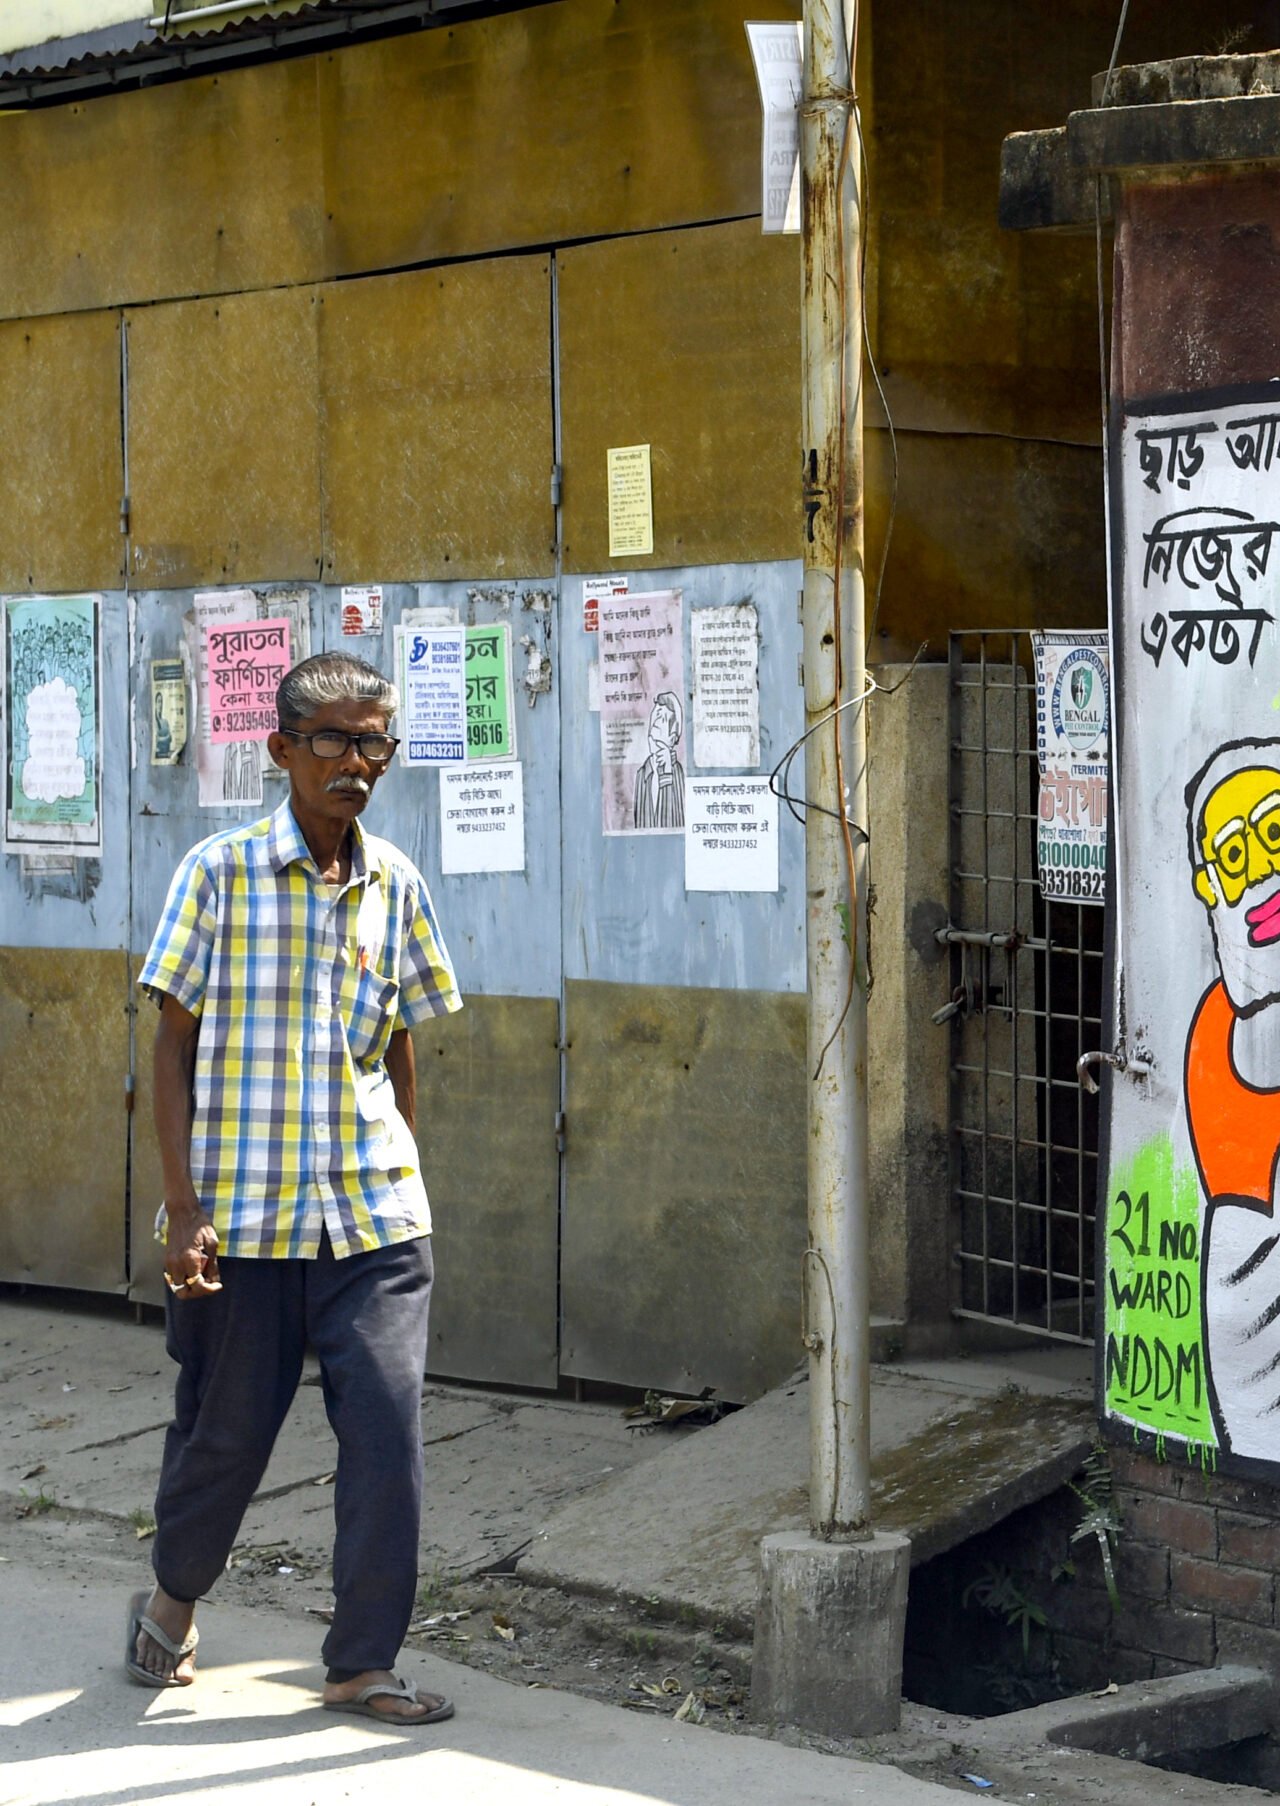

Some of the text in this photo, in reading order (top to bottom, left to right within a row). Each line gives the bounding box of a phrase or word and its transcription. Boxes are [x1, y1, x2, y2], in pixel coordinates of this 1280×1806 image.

[1141, 582, 1277, 670] একটা
[210, 627, 285, 664] পুরাতন
[220, 692, 252, 707] কেনা
[1065, 709, 1101, 722] BENGAL
[410, 743, 463, 758] 9874632311
[1109, 1267, 1192, 1319] WARD
[1106, 1332, 1202, 1409] NDDM
